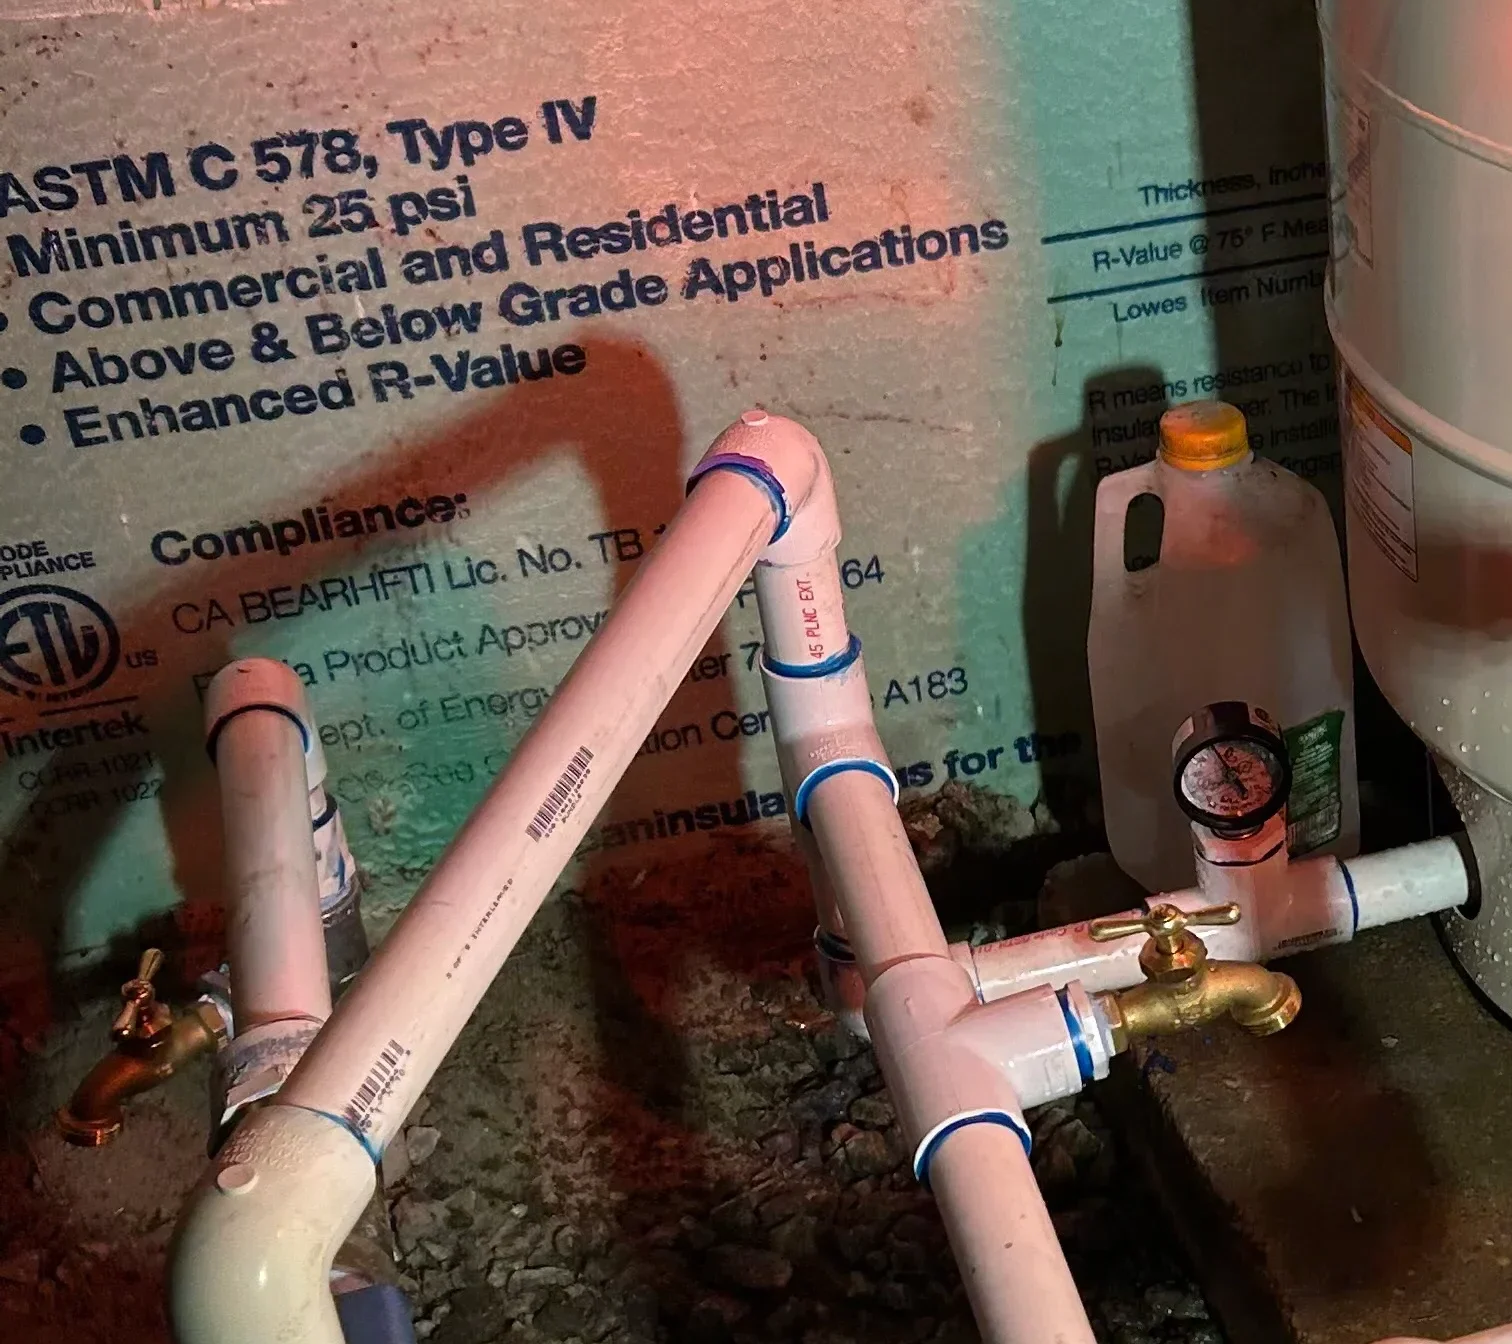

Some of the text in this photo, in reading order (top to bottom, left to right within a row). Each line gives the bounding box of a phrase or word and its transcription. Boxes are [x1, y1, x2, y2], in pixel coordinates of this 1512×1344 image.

[0, 94, 598, 218] ASTM C 578, Type IV
[1137, 160, 1328, 208] Thickness, Inche
[6, 173, 478, 278] Minimum 25 psi
[1092, 241, 1183, 273] R-Value
[1281, 216, 1329, 241] Mea
[26, 181, 832, 335] Commercial and Residential
[51, 216, 1010, 395] Above & Below Grade Applications
[1112, 295, 1188, 324] Lowes
[1200, 284, 1250, 309] Item
[63, 338, 588, 449] Enhanced R-Value
[1112, 375, 1188, 408] means
[0, 539, 48, 565] ODE
[151, 491, 471, 566] Compliance:
[0, 550, 96, 582] PLIANCE
[172, 601, 236, 636] CA
[239, 561, 437, 626] BEARHFTI
[449, 556, 509, 591] Lic.
[517, 542, 583, 580] No.
[588, 528, 644, 565] TB
[325, 628, 466, 685] Product
[477, 608, 610, 658] Approv
[883, 666, 970, 710] A183
[2, 709, 150, 759] Intertek
[318, 713, 387, 756] ept.
[398, 698, 432, 732] of
[943, 745, 1006, 781] for
